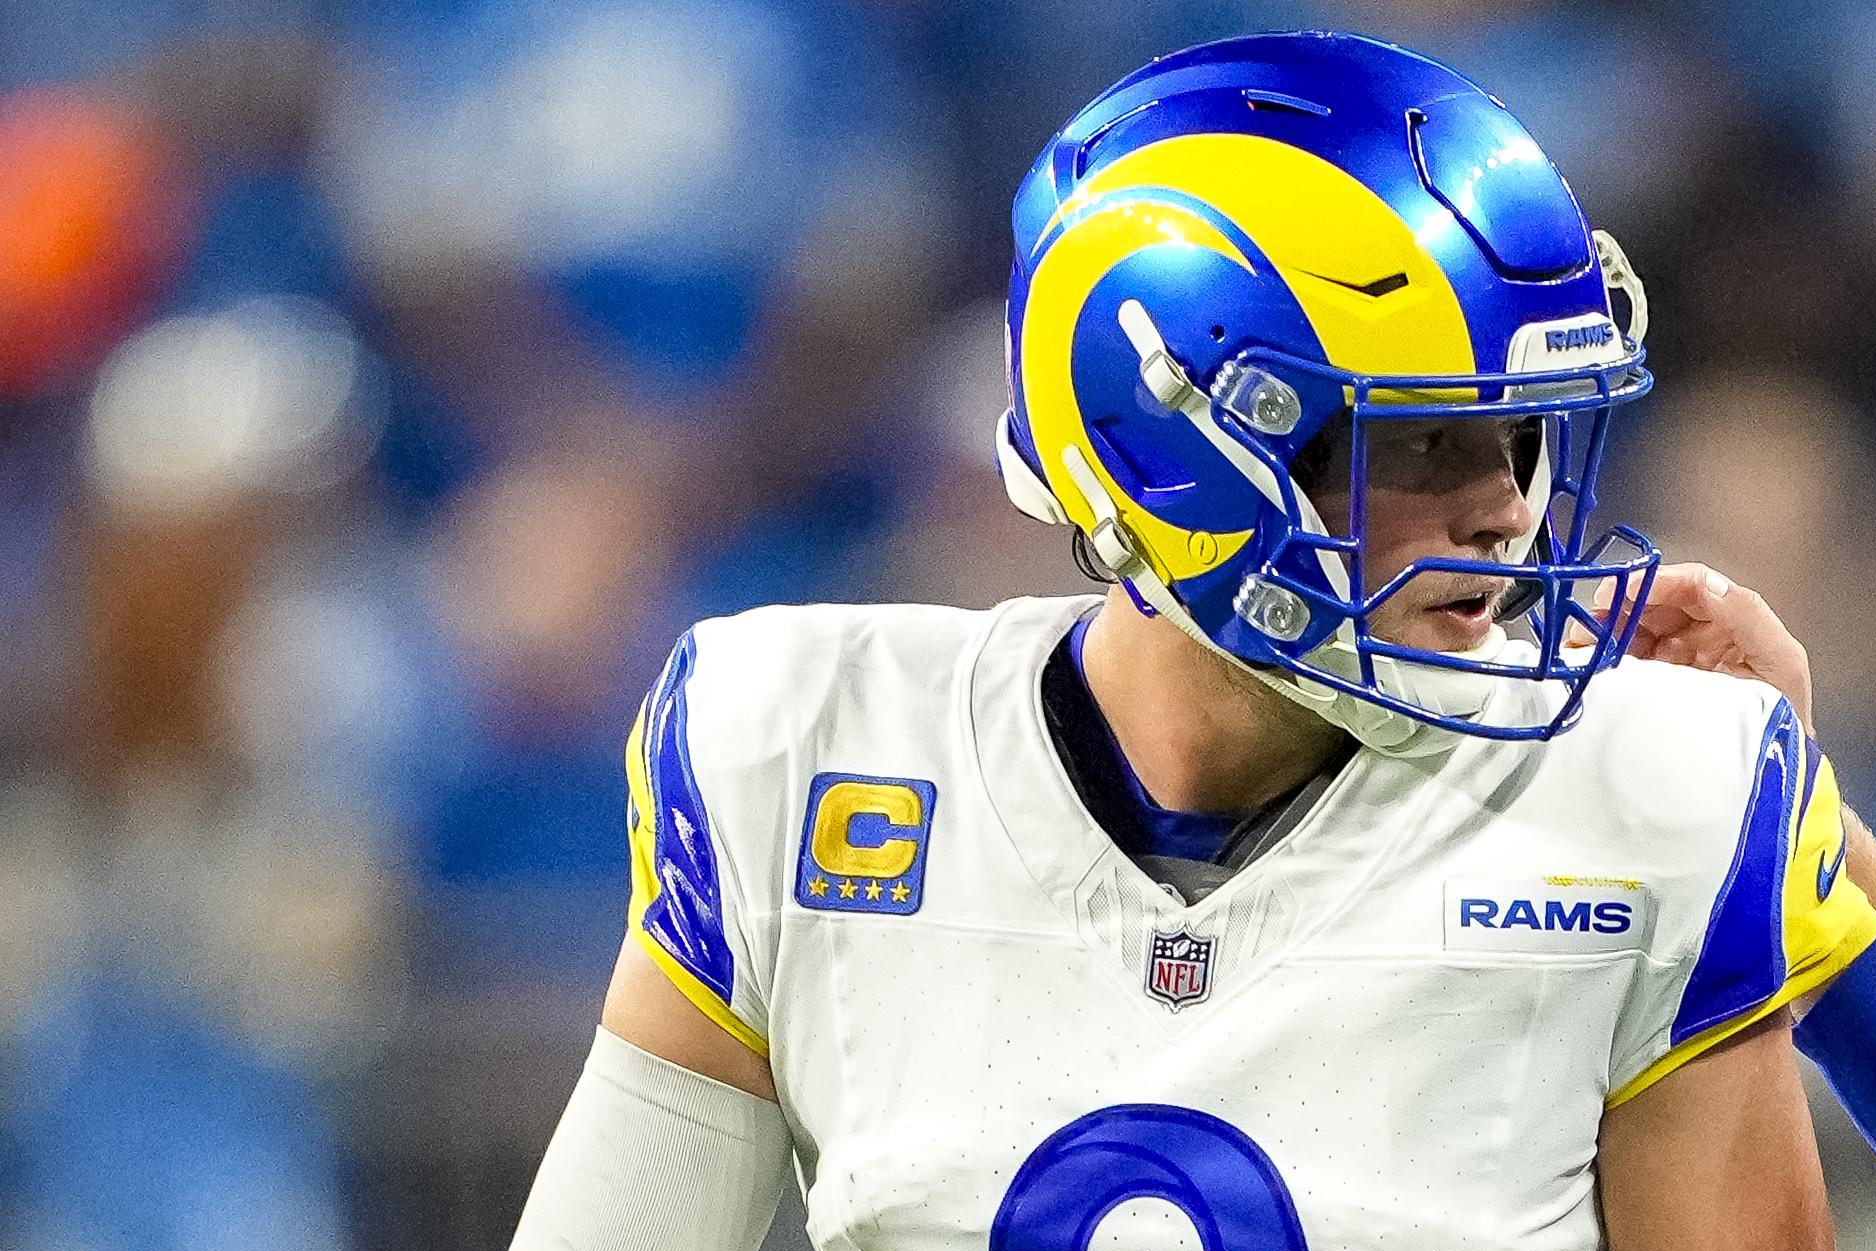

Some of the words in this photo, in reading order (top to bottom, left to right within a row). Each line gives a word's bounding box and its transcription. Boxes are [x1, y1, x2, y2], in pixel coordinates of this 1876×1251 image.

[1545, 323, 1614, 352] RAMS
[811, 781, 923, 879] C
[1460, 898, 1633, 934] RAMS
[1155, 961, 1201, 996] NFL
